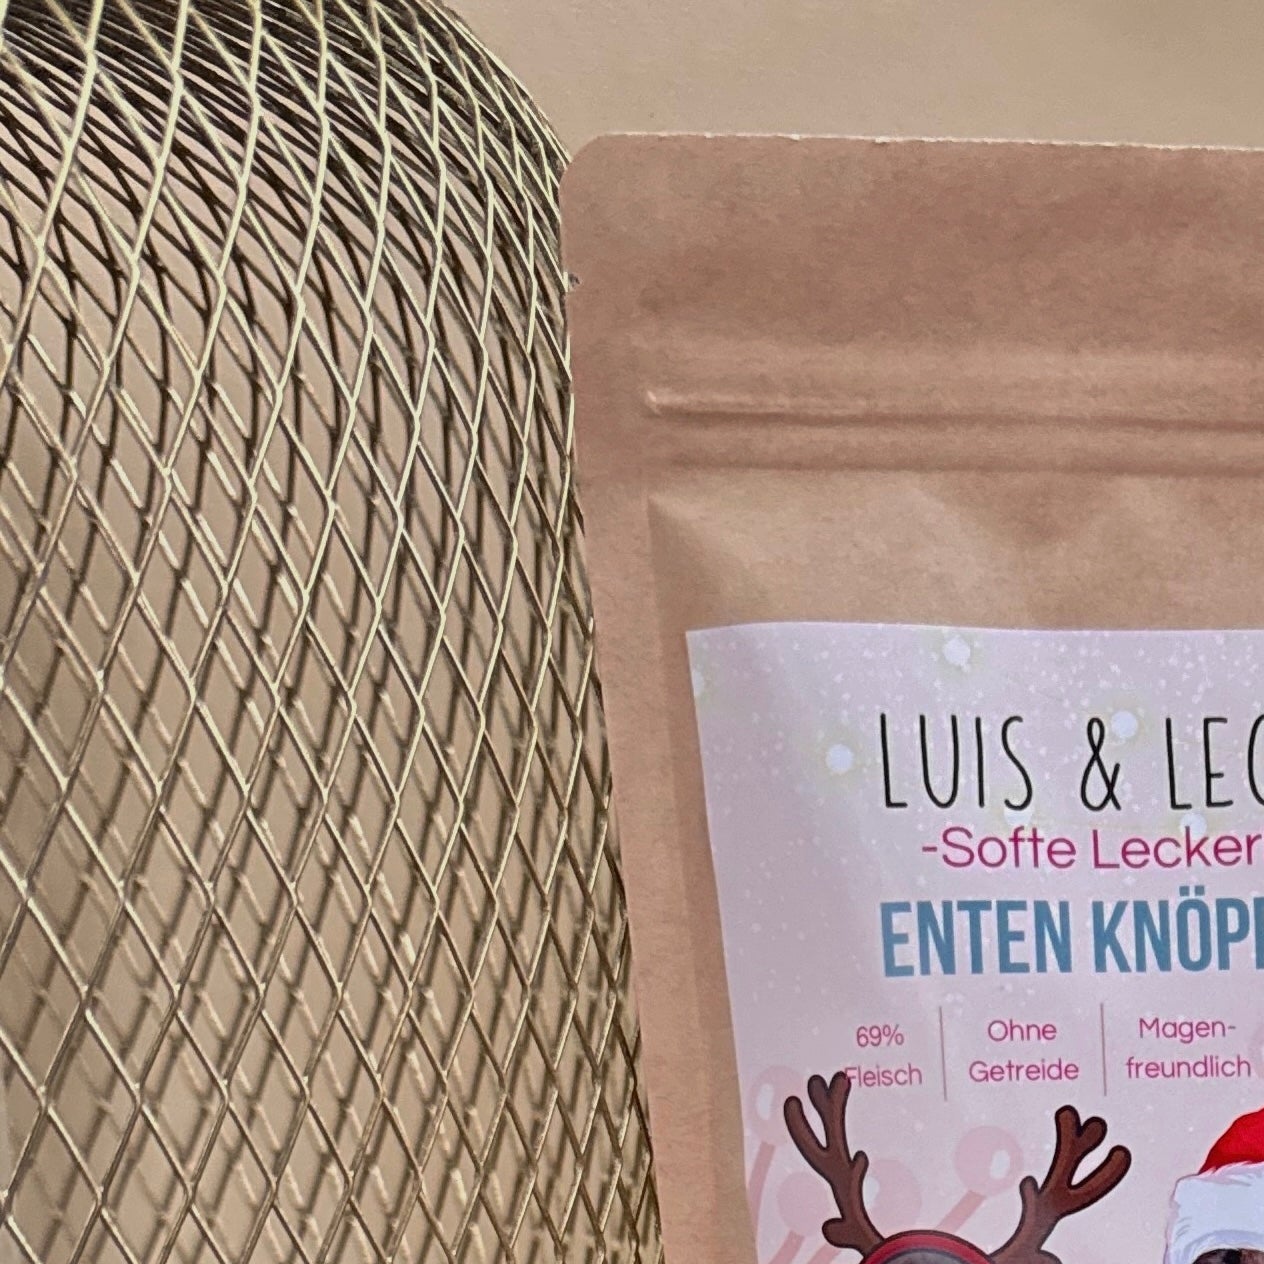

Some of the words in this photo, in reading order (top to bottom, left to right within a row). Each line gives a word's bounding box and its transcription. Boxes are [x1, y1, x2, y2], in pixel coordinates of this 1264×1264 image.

[879, 713, 1033, 810] LUIS
[1080, 716, 1122, 812] &
[921, 827, 1077, 870] -Softe
[880, 898, 1073, 977] ENTEN
[856, 1024, 904, 1047] 69%
[987, 1019, 1057, 1042] Ohne
[1138, 1017, 1236, 1044] Magen-
[968, 1057, 1080, 1083] Getreide
[1125, 1054, 1252, 1080] freundlich
